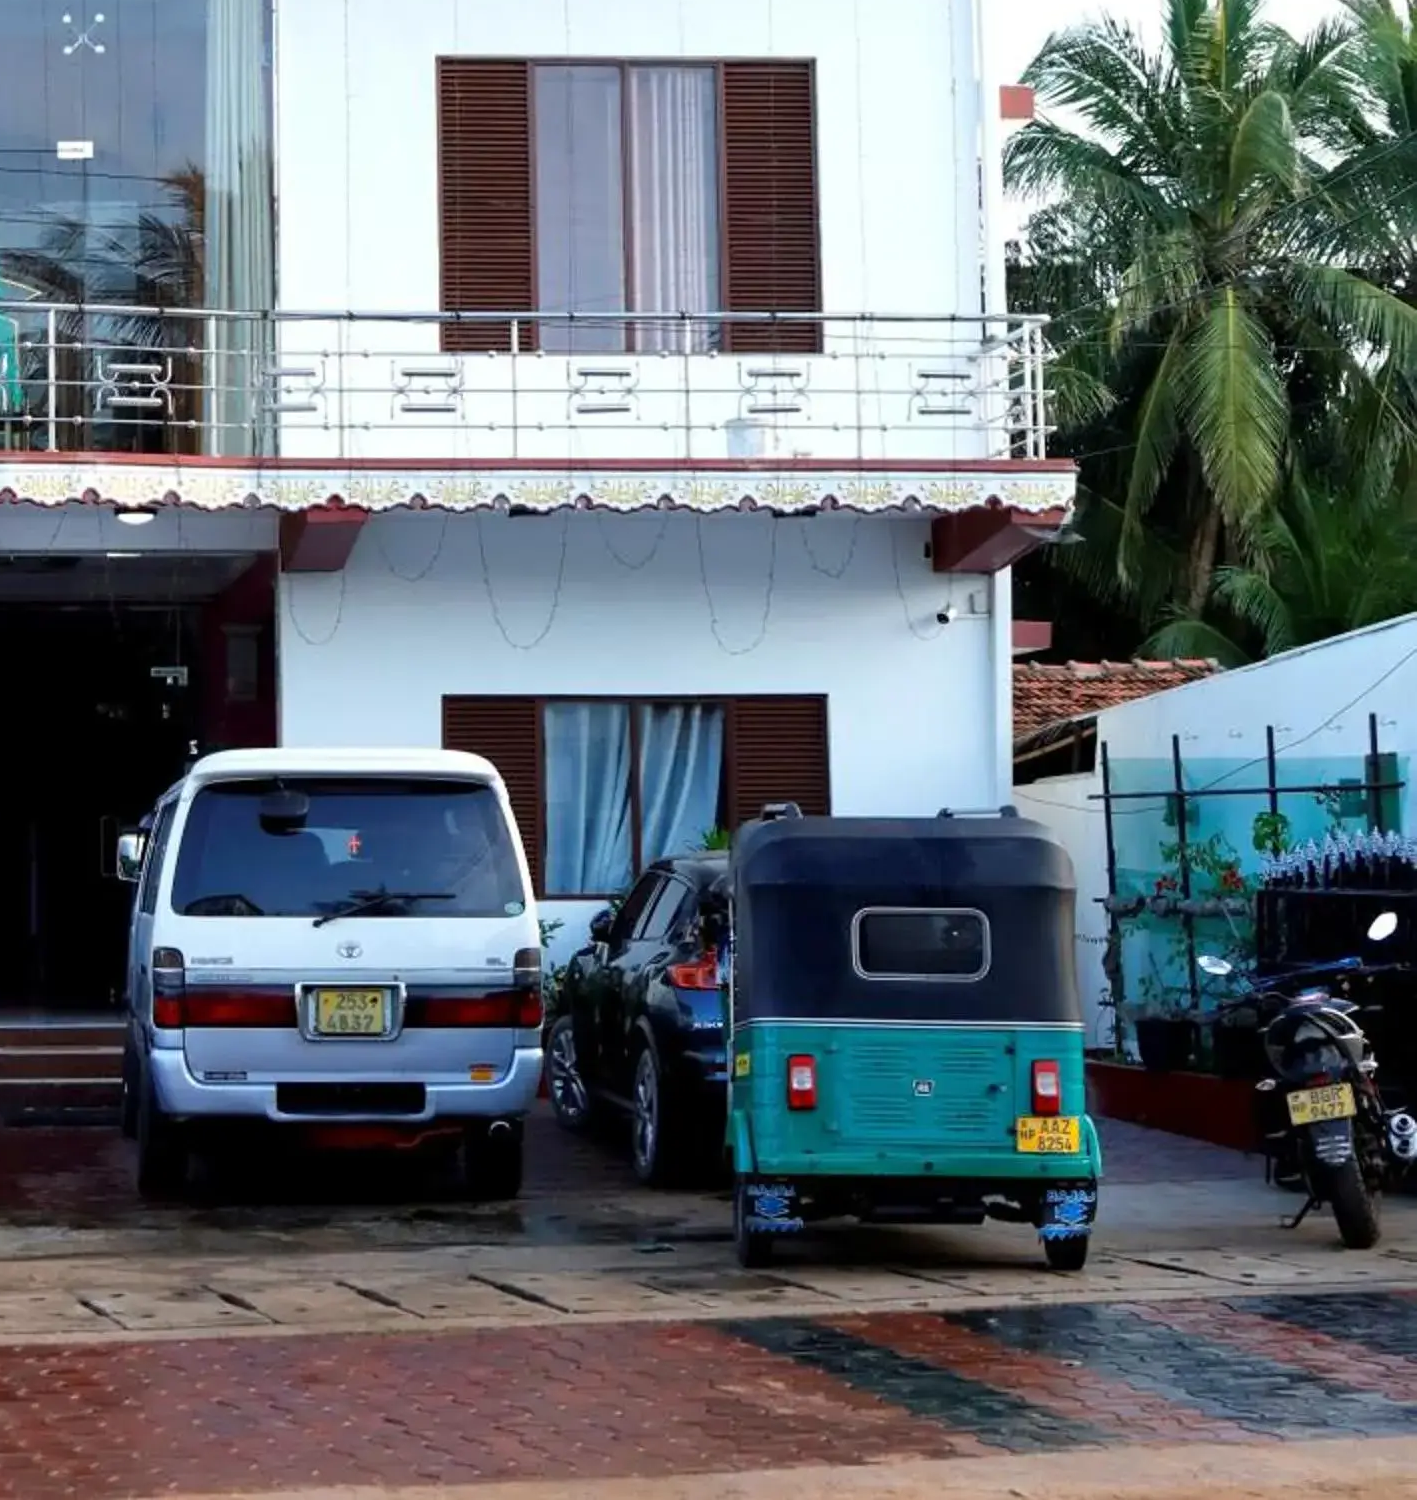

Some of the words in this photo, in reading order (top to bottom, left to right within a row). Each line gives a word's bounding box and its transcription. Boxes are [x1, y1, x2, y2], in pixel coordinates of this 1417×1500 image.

[335, 993, 368, 1010] 253
[1040, 1119, 1072, 1134] AAZ
[1037, 1135, 1072, 1151] 8254
